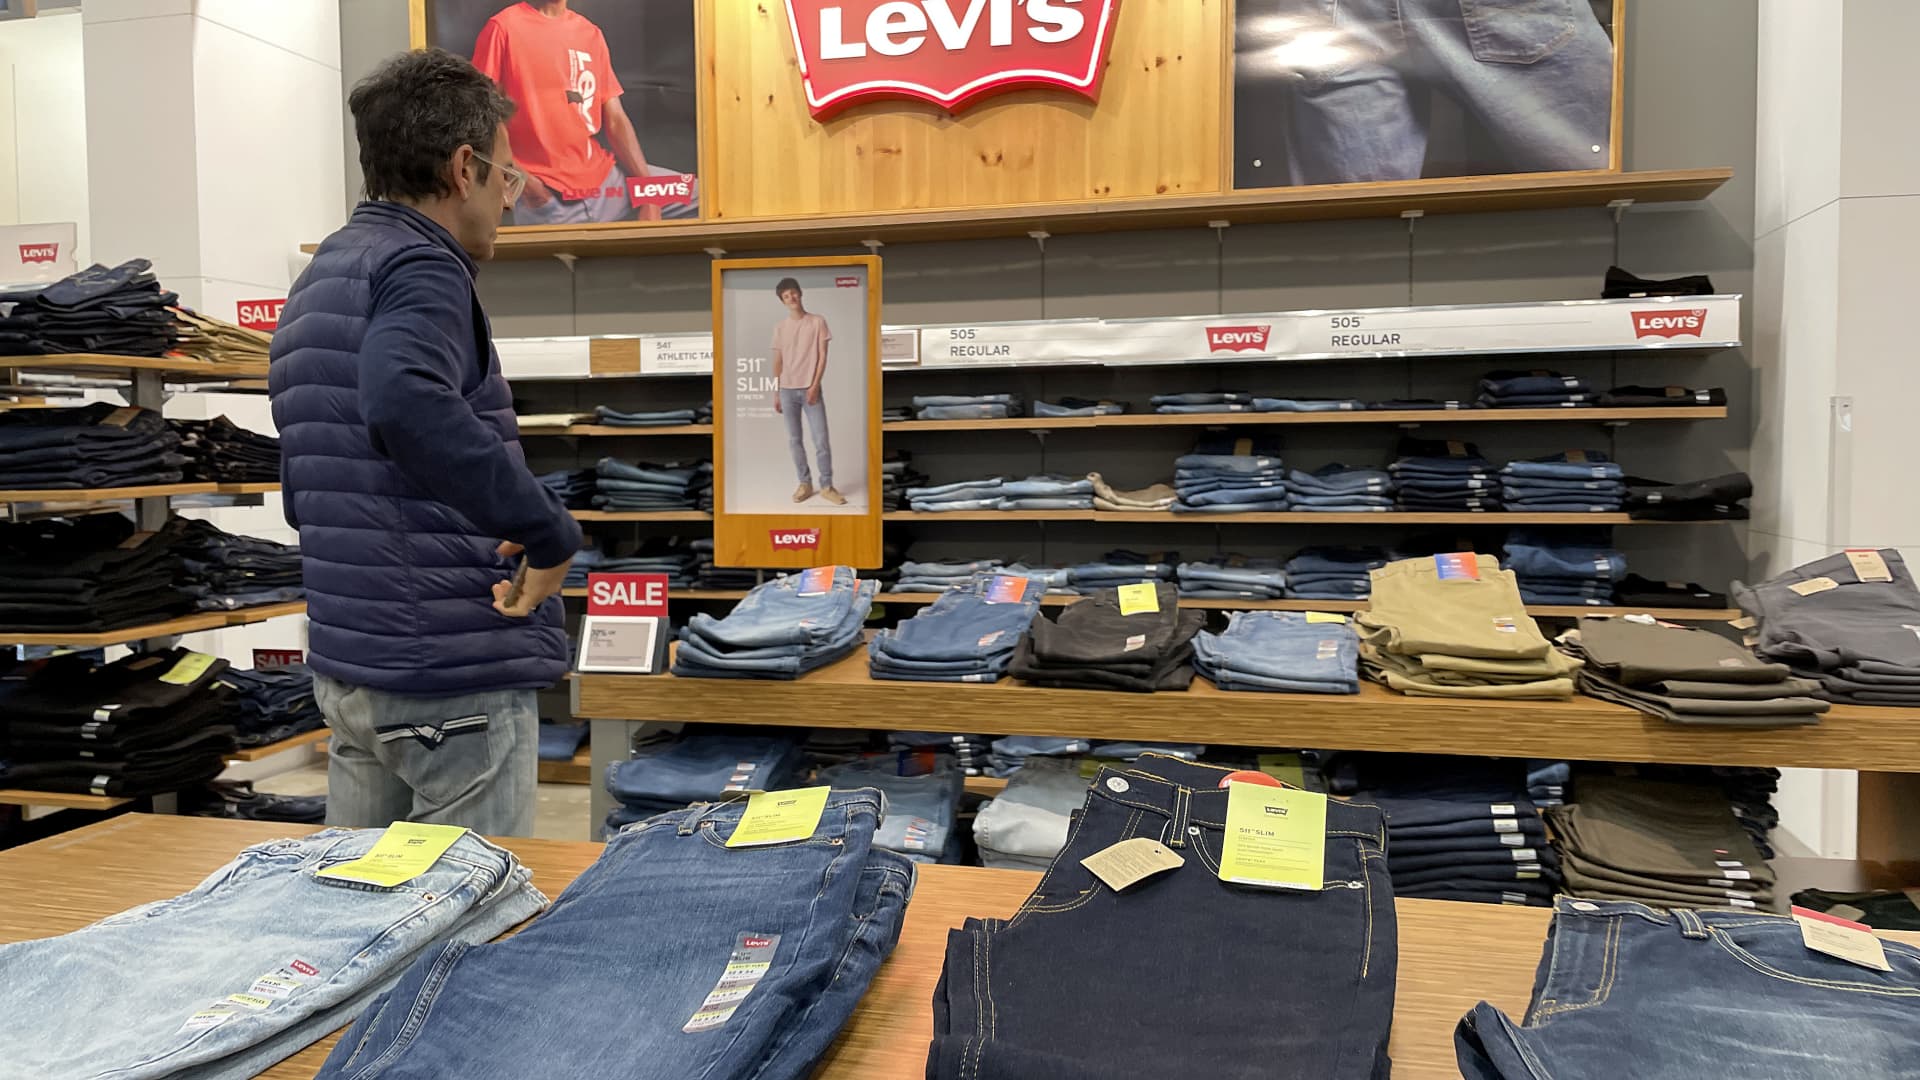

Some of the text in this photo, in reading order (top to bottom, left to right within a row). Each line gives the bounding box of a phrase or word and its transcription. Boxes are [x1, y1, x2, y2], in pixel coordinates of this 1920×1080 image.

[1331, 317, 1360, 328] 505
[950, 329, 976, 340] 505
[1331, 333, 1400, 347] REGULAR
[950, 345, 1010, 356] REGULAR
[657, 352, 698, 361] ATHLETIC
[736, 376, 779, 392] SLIM
[592, 581, 664, 606] SALE
